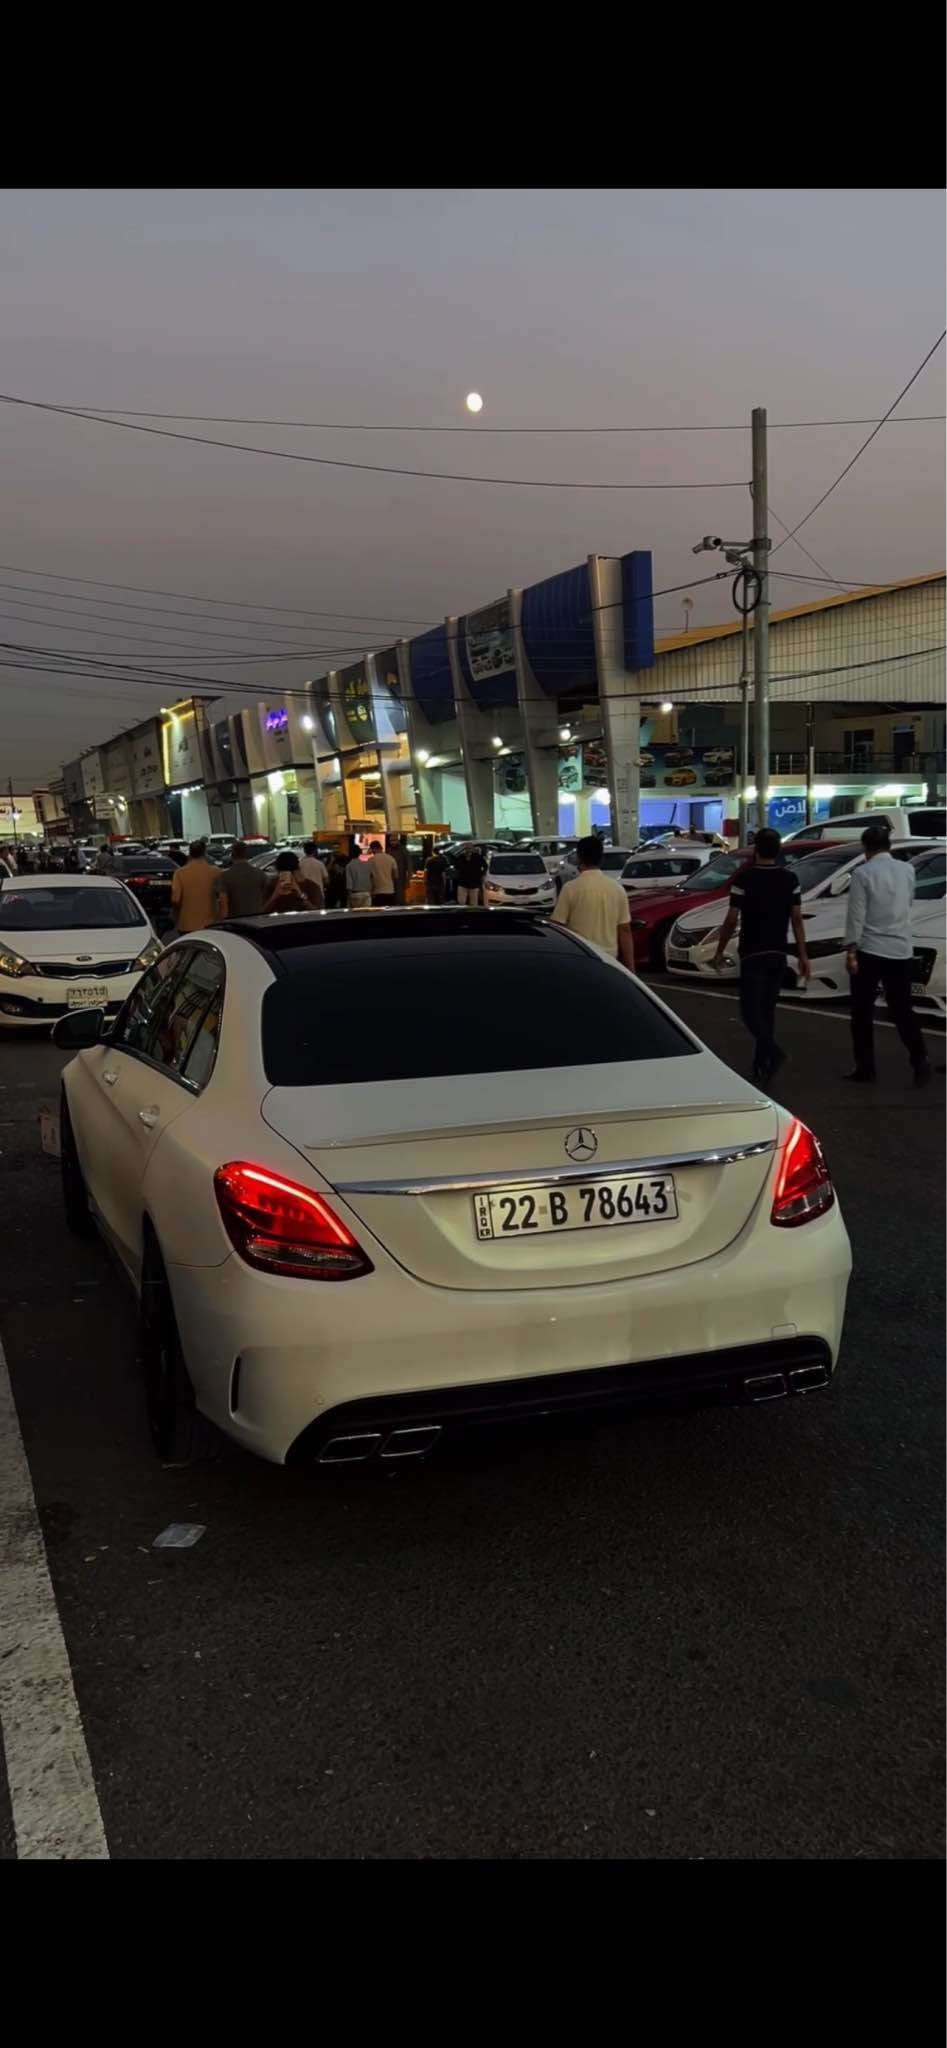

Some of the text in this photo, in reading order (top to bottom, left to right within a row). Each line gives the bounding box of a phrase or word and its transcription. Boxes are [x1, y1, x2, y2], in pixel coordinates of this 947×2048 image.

[499, 1181, 668, 1231] 22 B 78643
